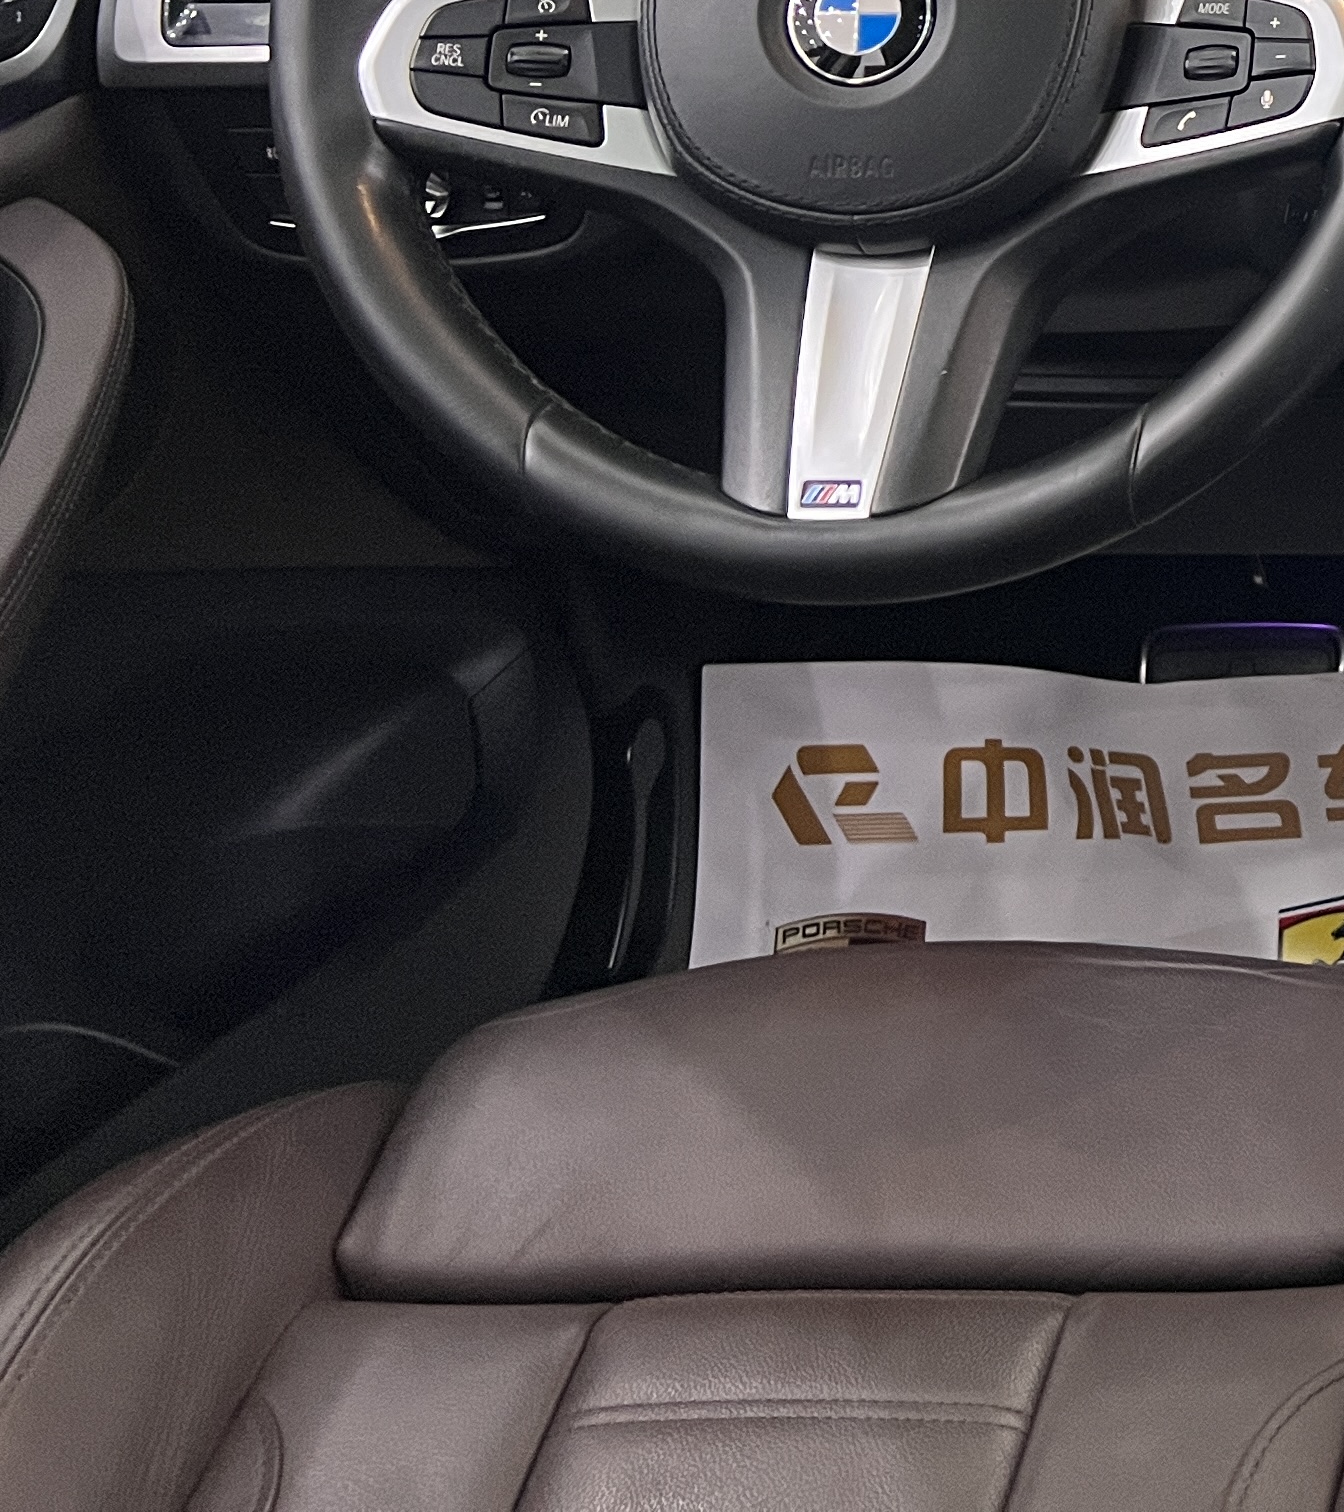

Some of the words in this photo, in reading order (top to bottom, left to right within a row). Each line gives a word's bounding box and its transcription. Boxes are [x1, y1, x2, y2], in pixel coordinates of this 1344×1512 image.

[1198, 2, 1230, 15] MODE
[436, 43, 461, 56] RES
[431, 53, 464, 68] CNCL
[545, 114, 570, 128] LIM
[810, 154, 894, 179] AIRBAG
[783, 918, 921, 944] PORSCHE
